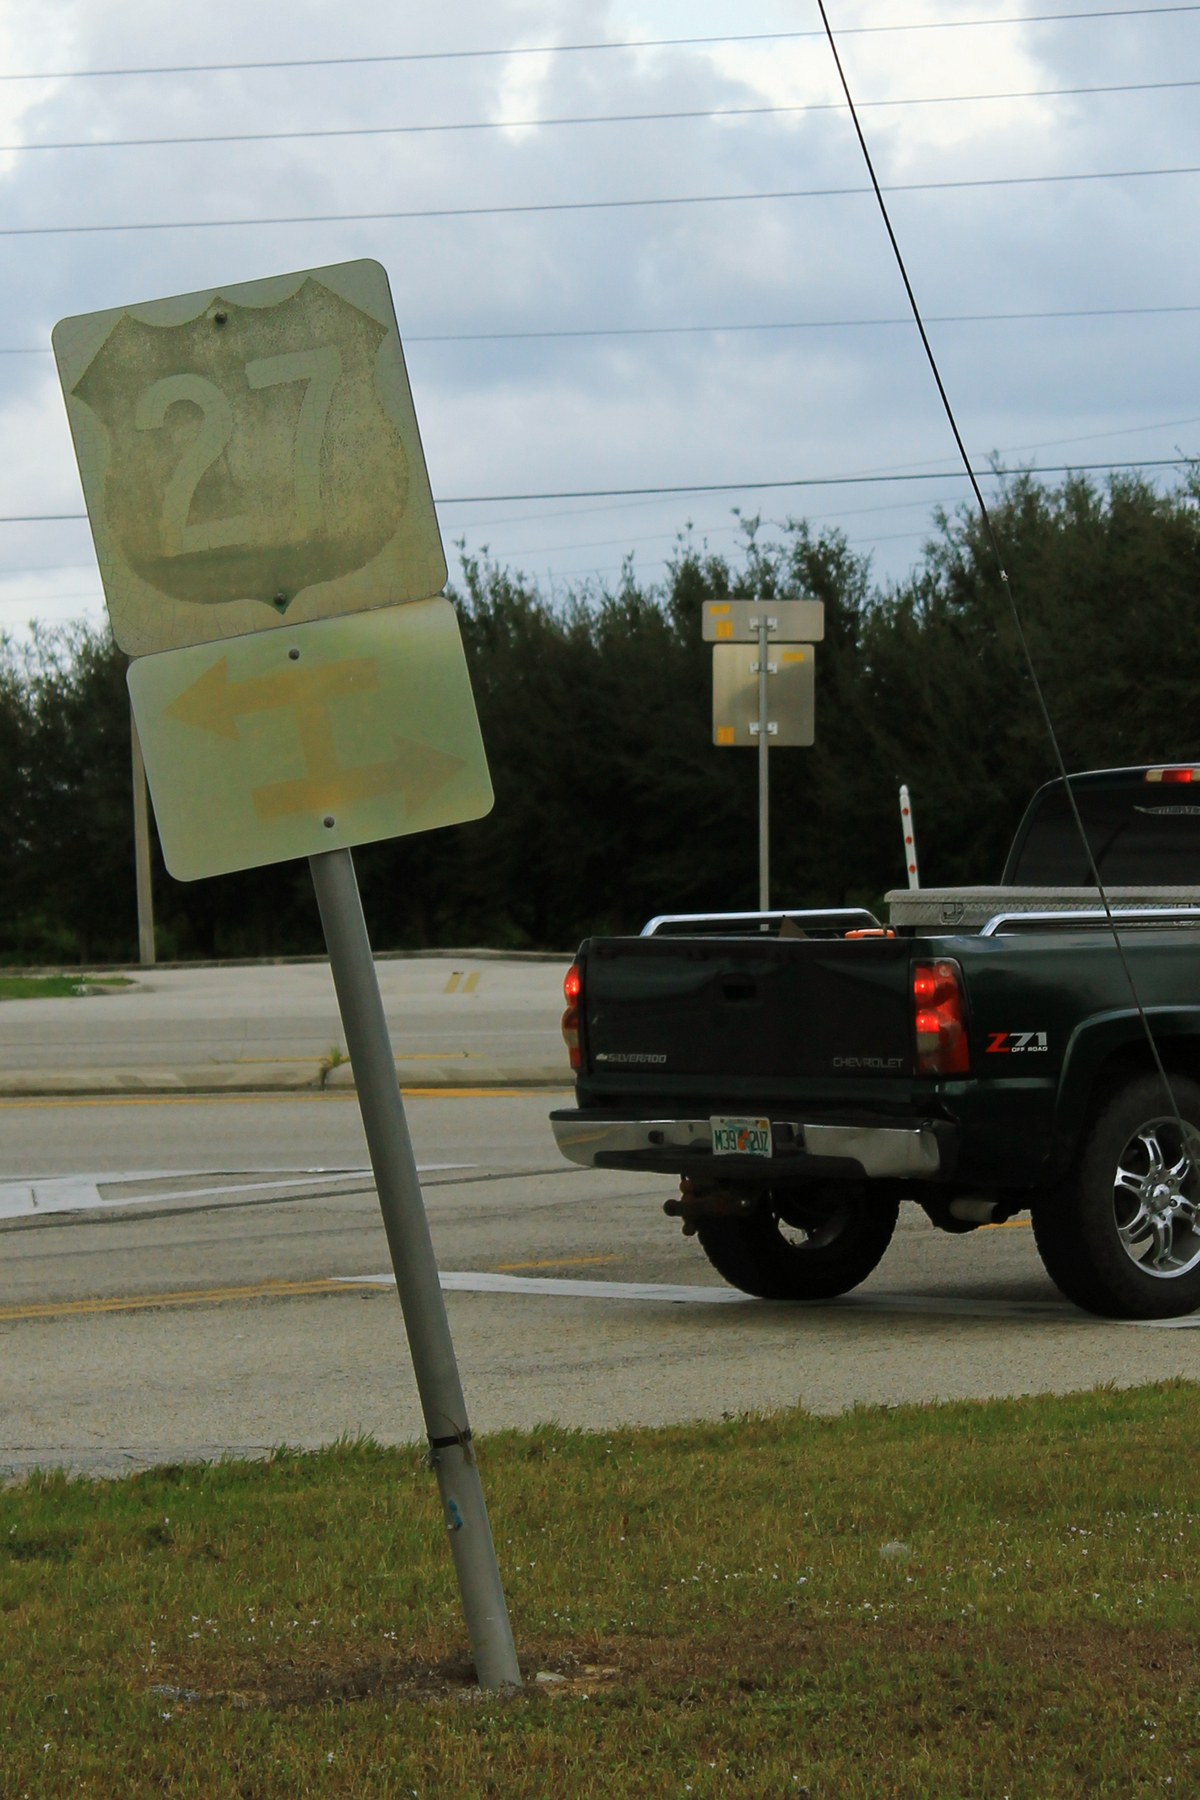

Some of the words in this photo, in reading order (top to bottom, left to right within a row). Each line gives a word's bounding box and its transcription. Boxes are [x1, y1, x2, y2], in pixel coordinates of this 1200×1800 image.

[136, 349, 341, 557] 27
[986, 1032, 1047, 1052] Z71
[607, 1053, 667, 1063] SILVERADO
[833, 1057, 904, 1068] CHEVROLET
[714, 1130, 737, 1150] M39
